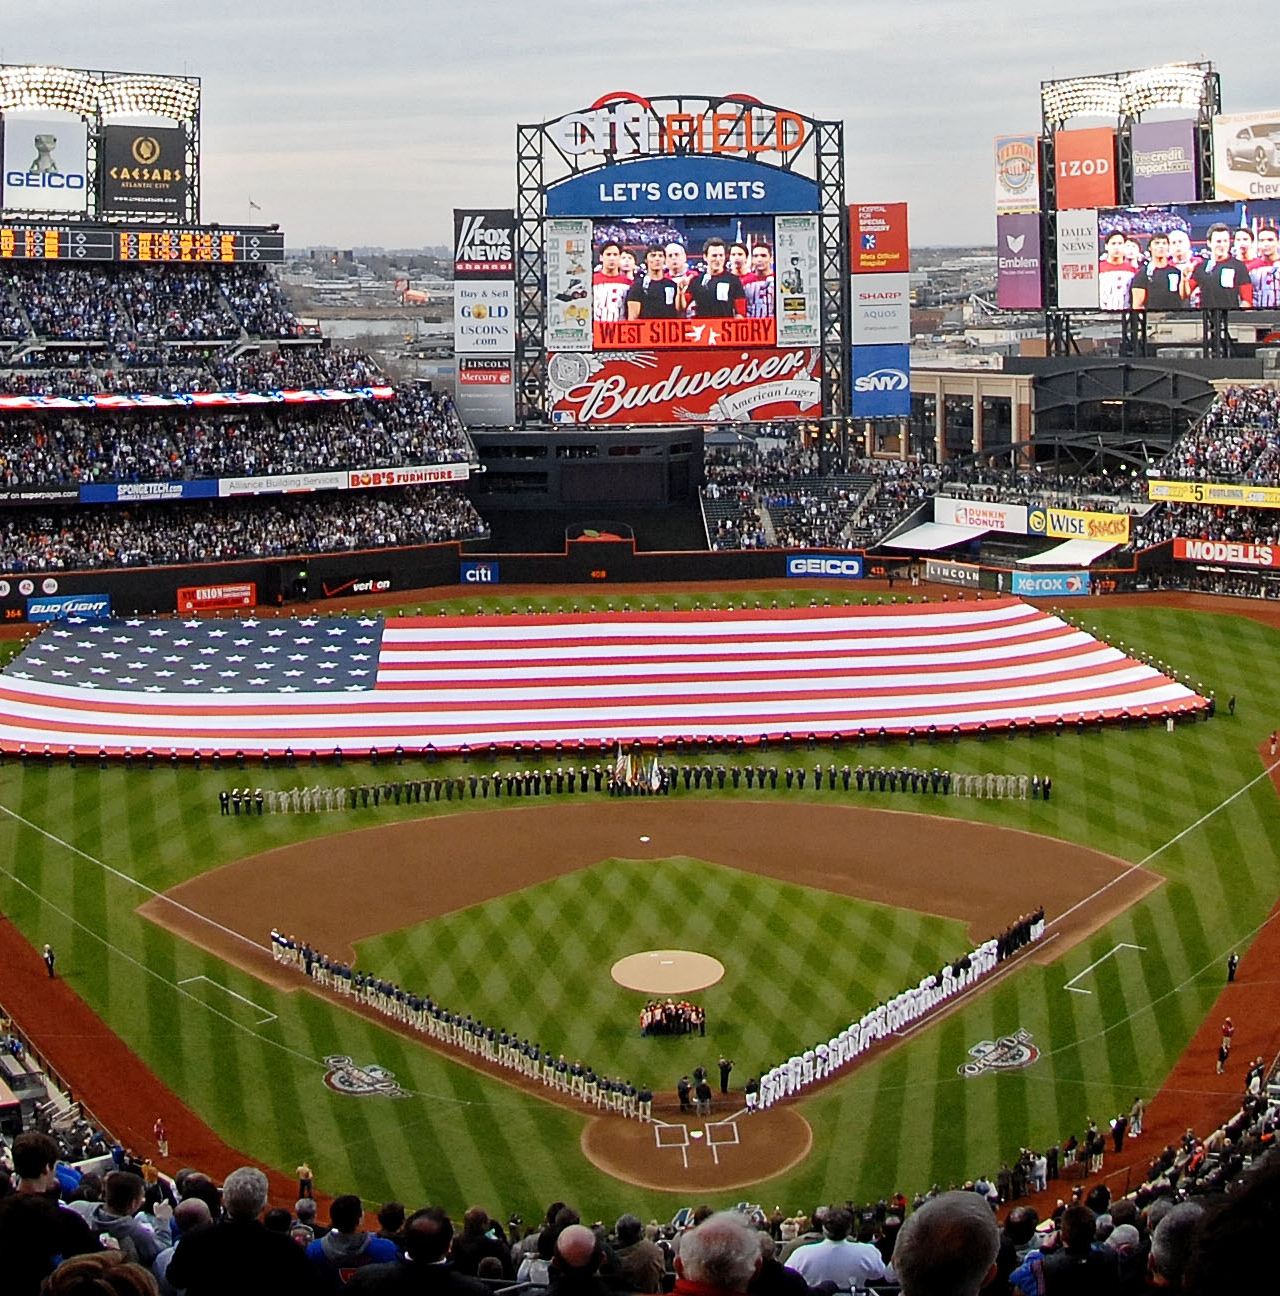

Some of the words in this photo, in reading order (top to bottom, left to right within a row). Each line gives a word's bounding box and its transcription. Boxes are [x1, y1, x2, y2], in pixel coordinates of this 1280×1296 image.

[666, 112, 805, 153] FIELD
[109, 167, 182, 182] CAESARS
[1060, 159, 1109, 177] IZOD
[7, 171, 84, 189] GEICO
[600, 183, 661, 202] LET'S
[667, 182, 699, 201] GO
[705, 180, 766, 200] METS
[474, 229, 511, 245] FOX
[1061, 227, 1094, 237] DAILY
[463, 245, 512, 261] NEWS
[1062, 242, 1094, 252] NEWS
[999, 256, 1039, 269] Emblem
[549, 238, 560, 326] RENTALS
[807, 235, 819, 320] SALES
[460, 290, 477, 298] Buy
[481, 290, 488, 298] &
[491, 290, 509, 298] Sell
[859, 292, 902, 300] SHARP
[863, 310, 897, 319] AQUOS
[460, 326, 509, 335] USCOINS
[600, 322, 645, 344] WEST
[650, 320, 692, 344] SIDE
[721, 320, 772, 343] STORY
[468, 360, 509, 368] LINCOLN
[461, 373, 498, 382] Mercury
[854, 376, 900, 392] SNY
[565, 350, 804, 422] Budweiser
[730, 388, 782, 412] American
[784, 385, 816, 400] Lager
[229, 479, 263, 490] Alliance
[266, 477, 301, 488] Building
[303, 475, 339, 485] Services
[350, 472, 394, 487] BOB'S
[396, 470, 453, 484] FURNITURE
[118, 483, 183, 495] SPONGETECH.com
[1190, 485, 1203, 501] $5
[969, 508, 1007, 519] DUNKIN'
[969, 518, 1006, 529] DONUTS
[1088, 518, 1126, 537] SNACKS
[1185, 540, 1273, 566] MODELL'S
[466, 567, 491, 582] citi
[790, 559, 859, 575] GEICO
[930, 566, 979, 581] LINCOLN
[0, 584, 7, 592] 41
[22, 583, 31, 591] 42
[353, 579, 390, 592] verizon
[1018, 577, 1063, 591] xerox
[196, 588, 223, 600] UNION
[29, 604, 61, 614] BUD
[64, 601, 108, 612] LIGHT
